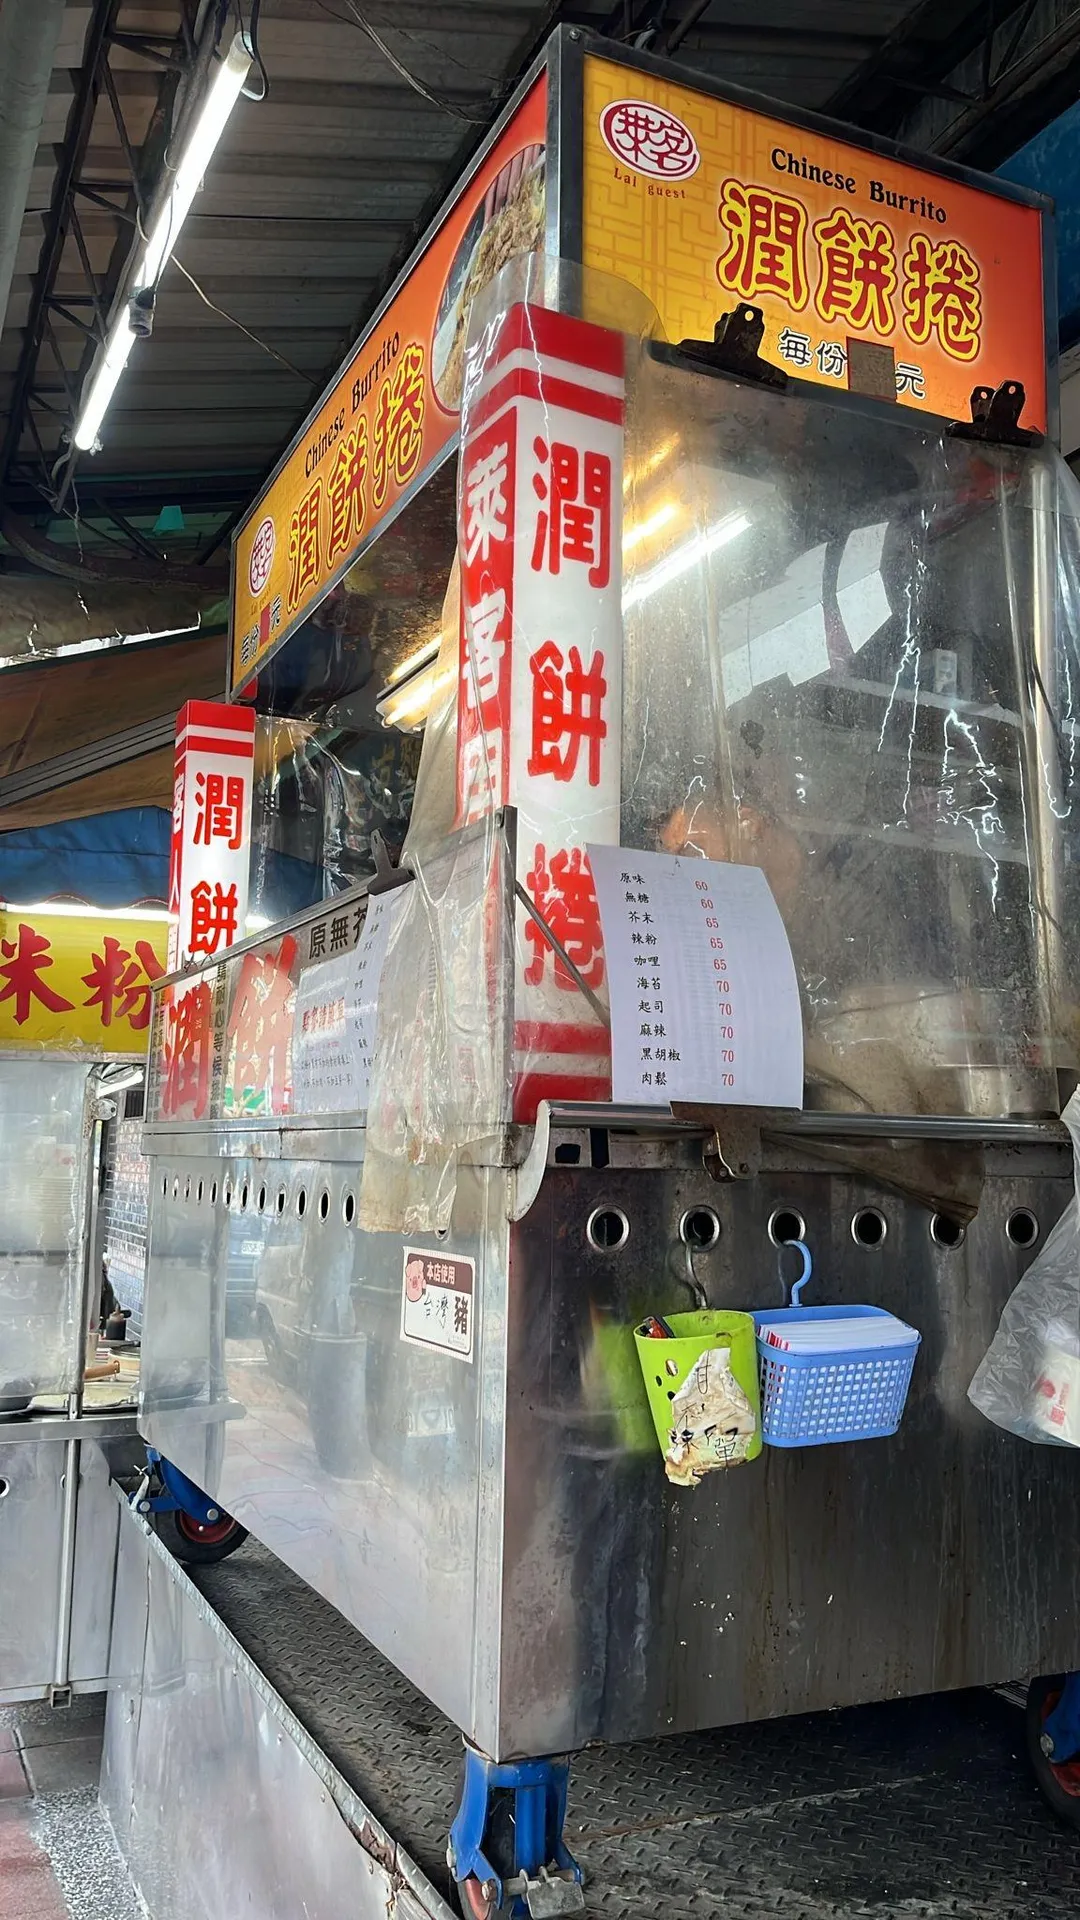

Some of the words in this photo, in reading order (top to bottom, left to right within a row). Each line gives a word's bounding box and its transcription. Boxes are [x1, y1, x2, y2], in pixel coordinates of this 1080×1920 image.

[647, 183, 686, 199] guest
[771, 148, 856, 194] Chinese
[869, 180, 947, 224] Burrito
[716, 177, 981, 362] 潤餅捲
[894, 363, 925, 398] 元
[305, 406, 346, 478] Chinese
[352, 331, 400, 415] Burrito
[286, 343, 424, 615] 潤餅捲
[524, 435, 611, 992] 潤餅捲
[619, 872, 646, 885] 原味
[695, 880, 708, 891] 60
[624, 891, 650, 904] 無糖
[700, 899, 714, 910] 60
[628, 911, 654, 924] 芥末
[705, 917, 719, 929] 65
[631, 933, 657, 946] 辣粉
[710, 938, 724, 950] 65
[634, 956, 661, 968] 咖哩
[713, 959, 727, 971] 65
[0, 923, 167, 1030] 米粉
[636, 977, 662, 991] 海苔
[716, 981, 730, 993] 70
[638, 1000, 664, 1014] 起司
[719, 1003, 732, 1016] 70
[639, 1024, 667, 1038] 麻辣
[721, 1026, 734, 1039] 70
[640, 1048, 681, 1062] 黑胡椒
[721, 1050, 735, 1063] 70
[641, 1072, 667, 1086] 肉鬆
[721, 1073, 735, 1087] 70
[426, 1261, 456, 1285] 本店使用
